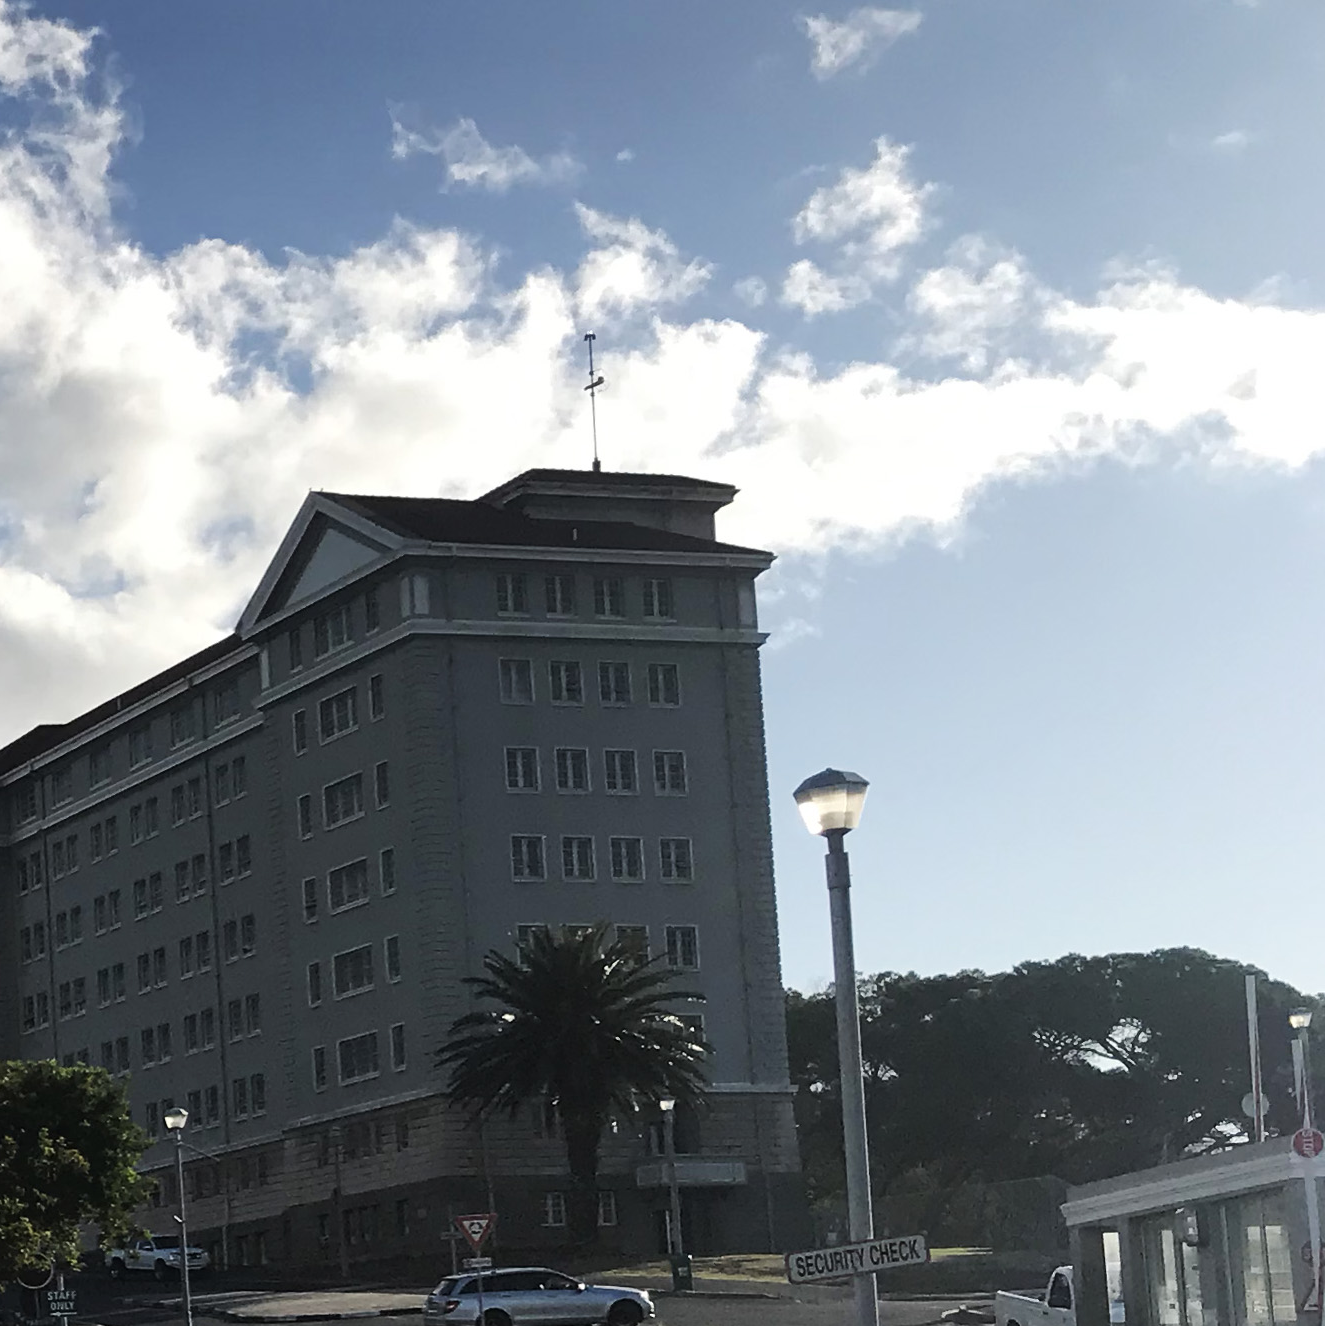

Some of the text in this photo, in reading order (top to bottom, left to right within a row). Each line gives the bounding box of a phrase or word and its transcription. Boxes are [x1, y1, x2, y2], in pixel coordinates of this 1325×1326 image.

[795, 1239, 921, 1277] SECURITY CHECK
[47, 1291, 77, 1301] STAFF
[50, 1302, 75, 1310] ONLY
